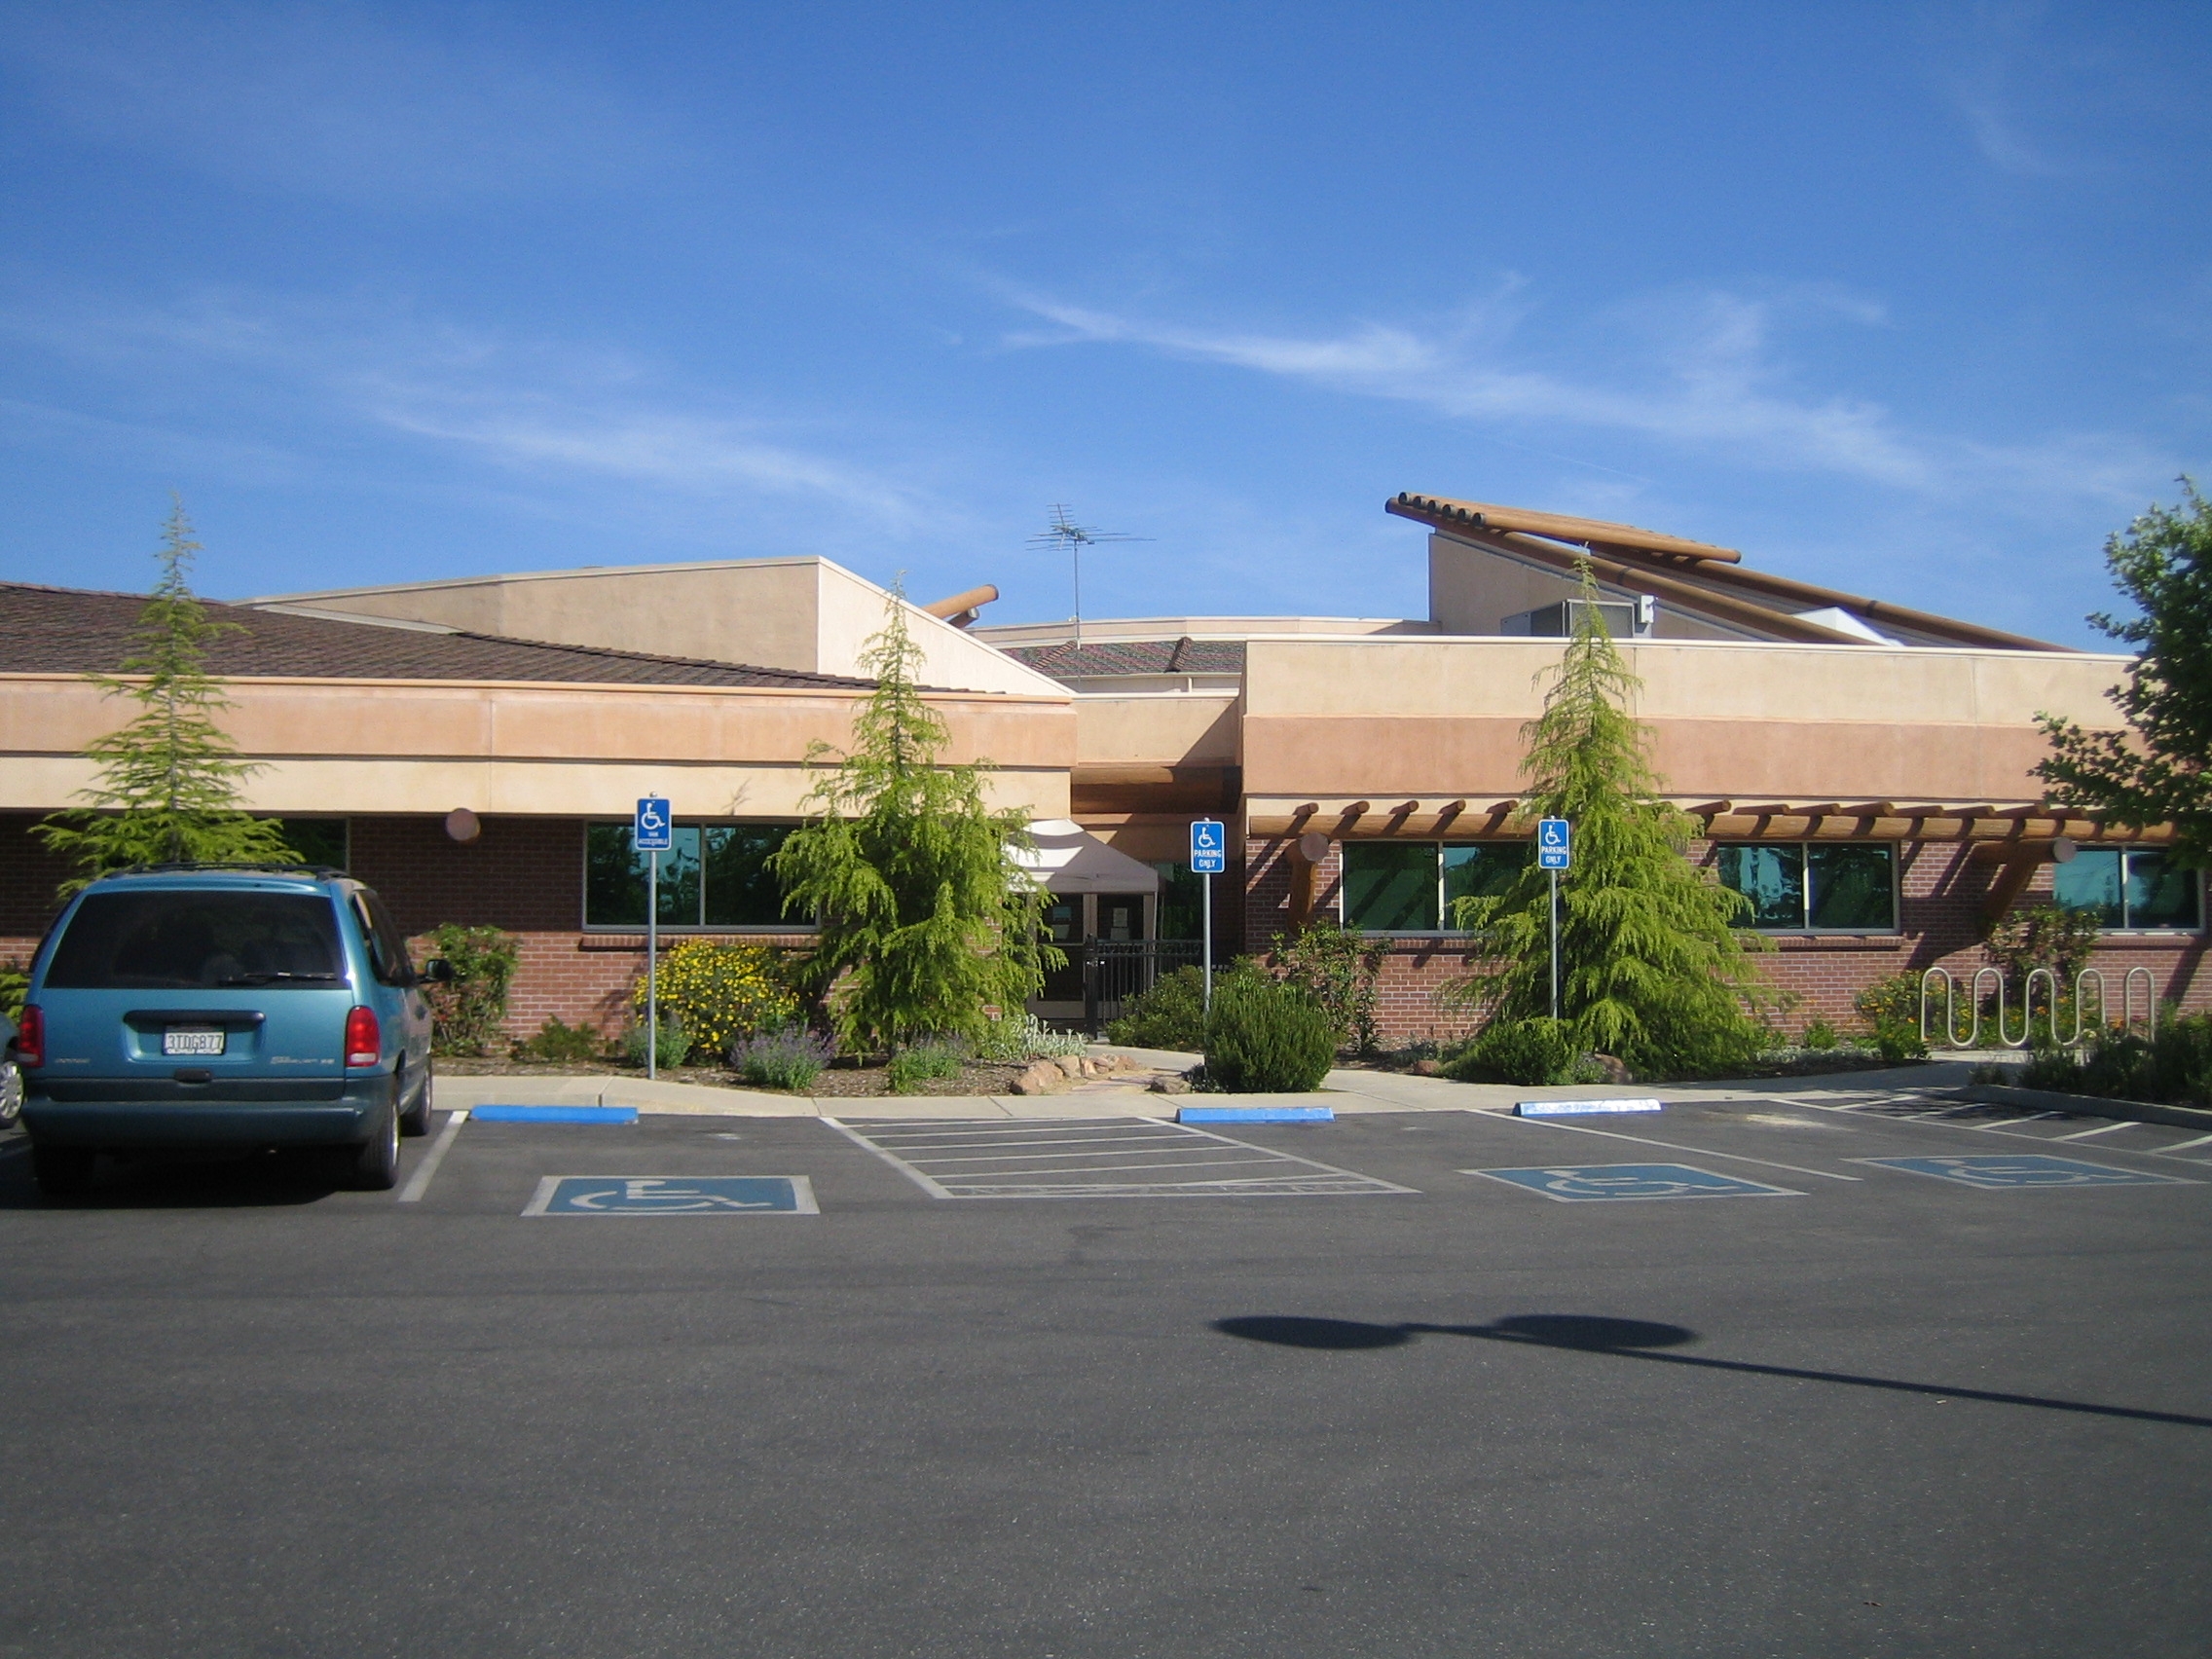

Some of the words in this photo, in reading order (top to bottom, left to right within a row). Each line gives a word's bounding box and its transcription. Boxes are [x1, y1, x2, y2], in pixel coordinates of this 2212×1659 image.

[1194, 849, 1222, 858] PARKING
[1541, 846, 1567, 855] PARKING
[1198, 859, 1216, 867] ONLY
[1545, 855, 1562, 864] ONLY
[167, 1034, 223, 1050] 3TDG877
